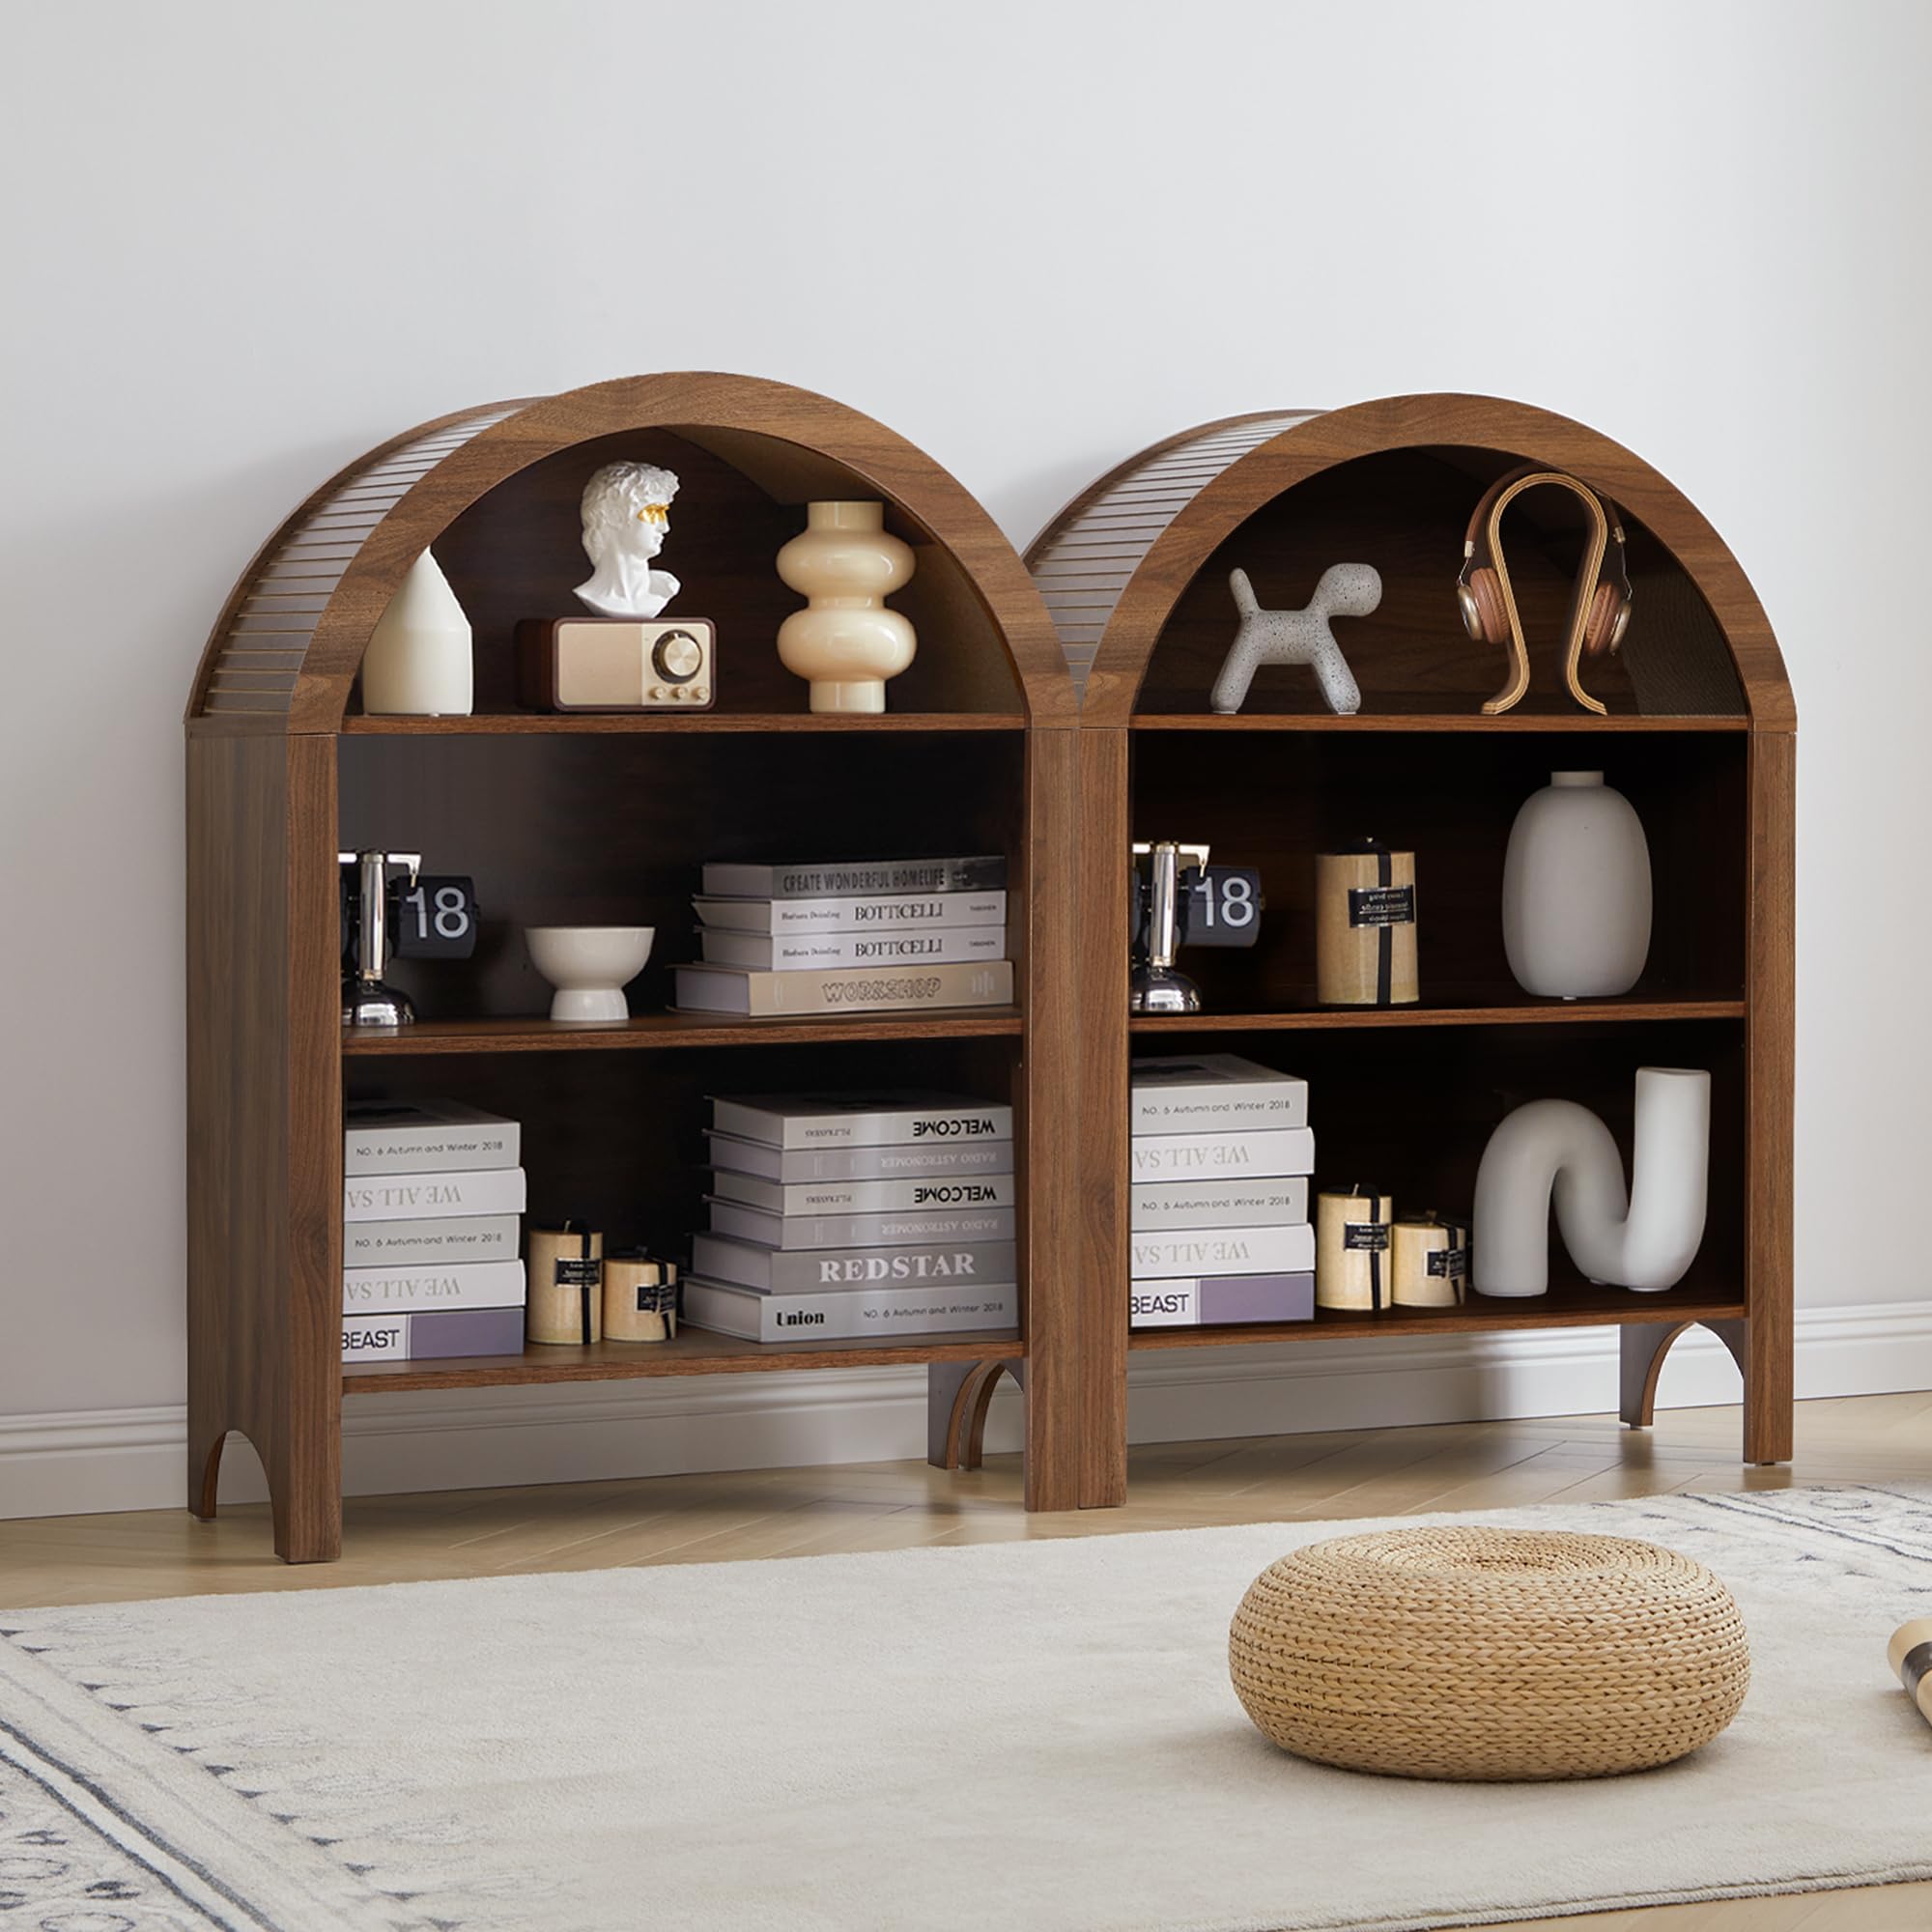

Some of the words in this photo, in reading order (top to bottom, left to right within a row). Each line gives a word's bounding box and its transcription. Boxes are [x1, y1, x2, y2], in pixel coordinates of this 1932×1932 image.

[783, 873, 821, 893] CREATE
[823, 870, 890, 891] WONDERFUL
[893, 867, 945, 887] HOMELIFE
[855, 903, 943, 921] BOTTICELLI
[1195, 877, 1254, 927] 18
[406, 887, 469, 938] 18
[855, 939, 943, 957] BOTTICELLI
[822, 977, 942, 1003] WORKSHOP
[1173, 1104, 1208, 1114] Autumn
[1211, 1101, 1230, 1112] and
[1234, 1101, 1265, 1111] Winter
[1269, 1099, 1291, 1110] 2018
[912, 1119, 996, 1138] WELCOME
[387, 1145, 423, 1155] Autumn
[424, 1143, 443, 1152] and
[446, 1142, 478, 1151] Winter
[482, 1141, 503, 1151] 2018
[960, 1151, 997, 1163] RADIO
[1166, 1147, 1208, 1167] ALL
[1213, 1145, 1250, 1165] WE
[880, 1152, 958, 1169] ASTRONOMER
[378, 1186, 421, 1207] ALL
[426, 1183, 463, 1205] WE
[914, 1185, 997, 1205] WELCOME
[1173, 1200, 1208, 1209] Autumn
[1211, 1198, 1230, 1208] and
[1234, 1197, 1265, 1207] Winter
[1269, 1196, 1291, 1206] 2018
[881, 1219, 959, 1236] ASTRONOMER
[961, 1218, 998, 1231] RADIO
[386, 1236, 423, 1246] Autumn
[424, 1235, 442, 1244] and
[446, 1234, 477, 1243] Winter
[481, 1233, 502, 1242] 2018
[1166, 1242, 1208, 1263] ALL
[1213, 1241, 1251, 1261] WE
[819, 1253, 976, 1283] REDSTAR
[377, 1279, 420, 1299] ALL
[425, 1277, 462, 1297] WE
[776, 1309, 825, 1326] Union
[883, 1309, 890, 1319] 6
[893, 1306, 927, 1317] Autumn
[928, 1304, 947, 1316] and
[950, 1303, 980, 1314] Winter
[982, 1301, 1004, 1313] 2018
